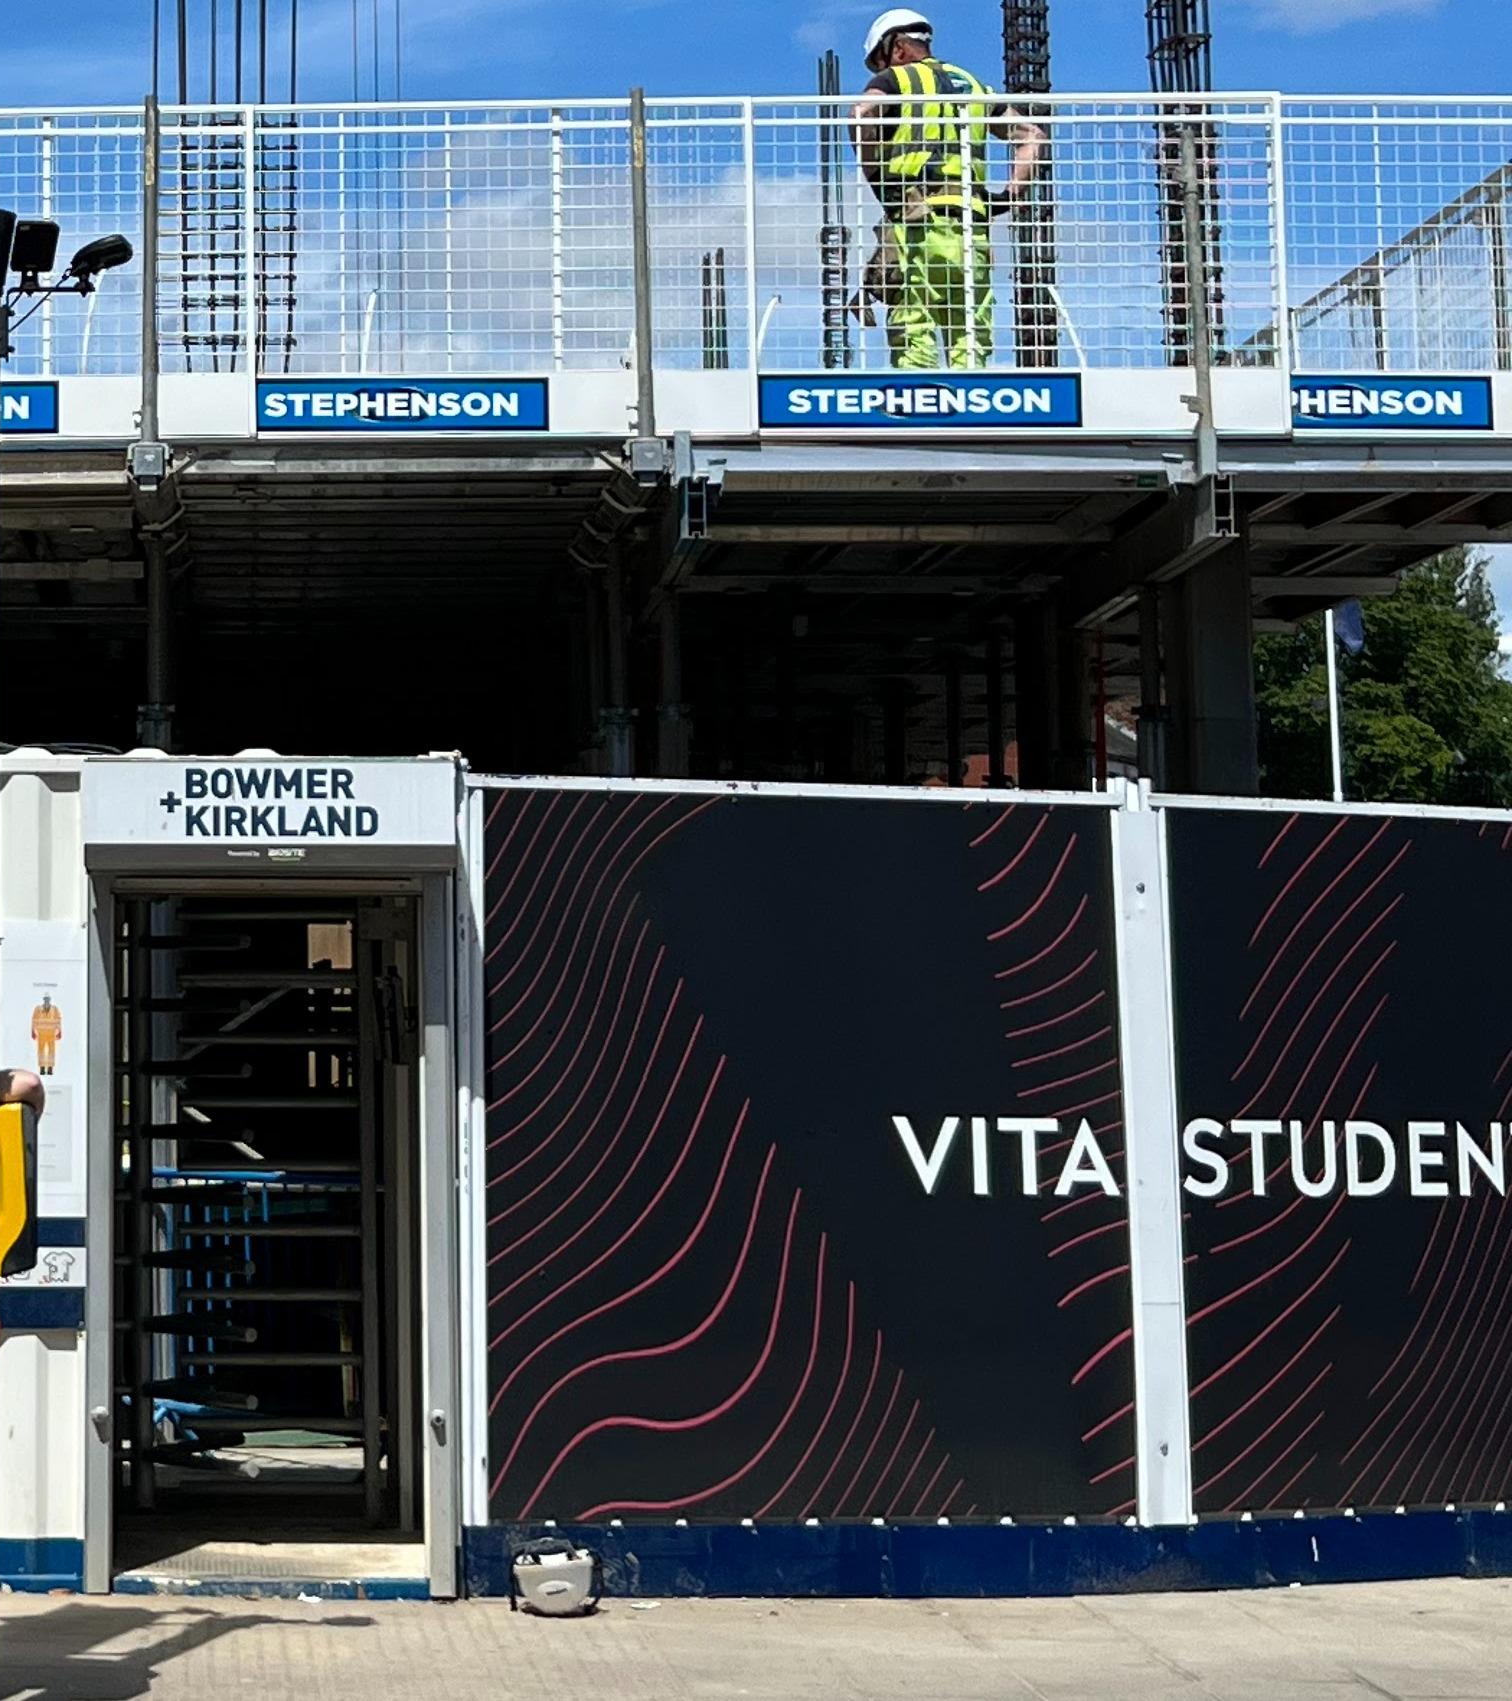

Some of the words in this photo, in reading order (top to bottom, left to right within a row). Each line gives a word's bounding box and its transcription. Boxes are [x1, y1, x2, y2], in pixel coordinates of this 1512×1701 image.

[265, 391, 520, 418] STEPHENSON
[788, 387, 1051, 415] STEPHENSON
[185, 768, 355, 799] BOWMER
[185, 806, 379, 837] KIRKLAND
[892, 1115, 1120, 1196] VITA
[1183, 1117, 1512, 1197] STUDEN
